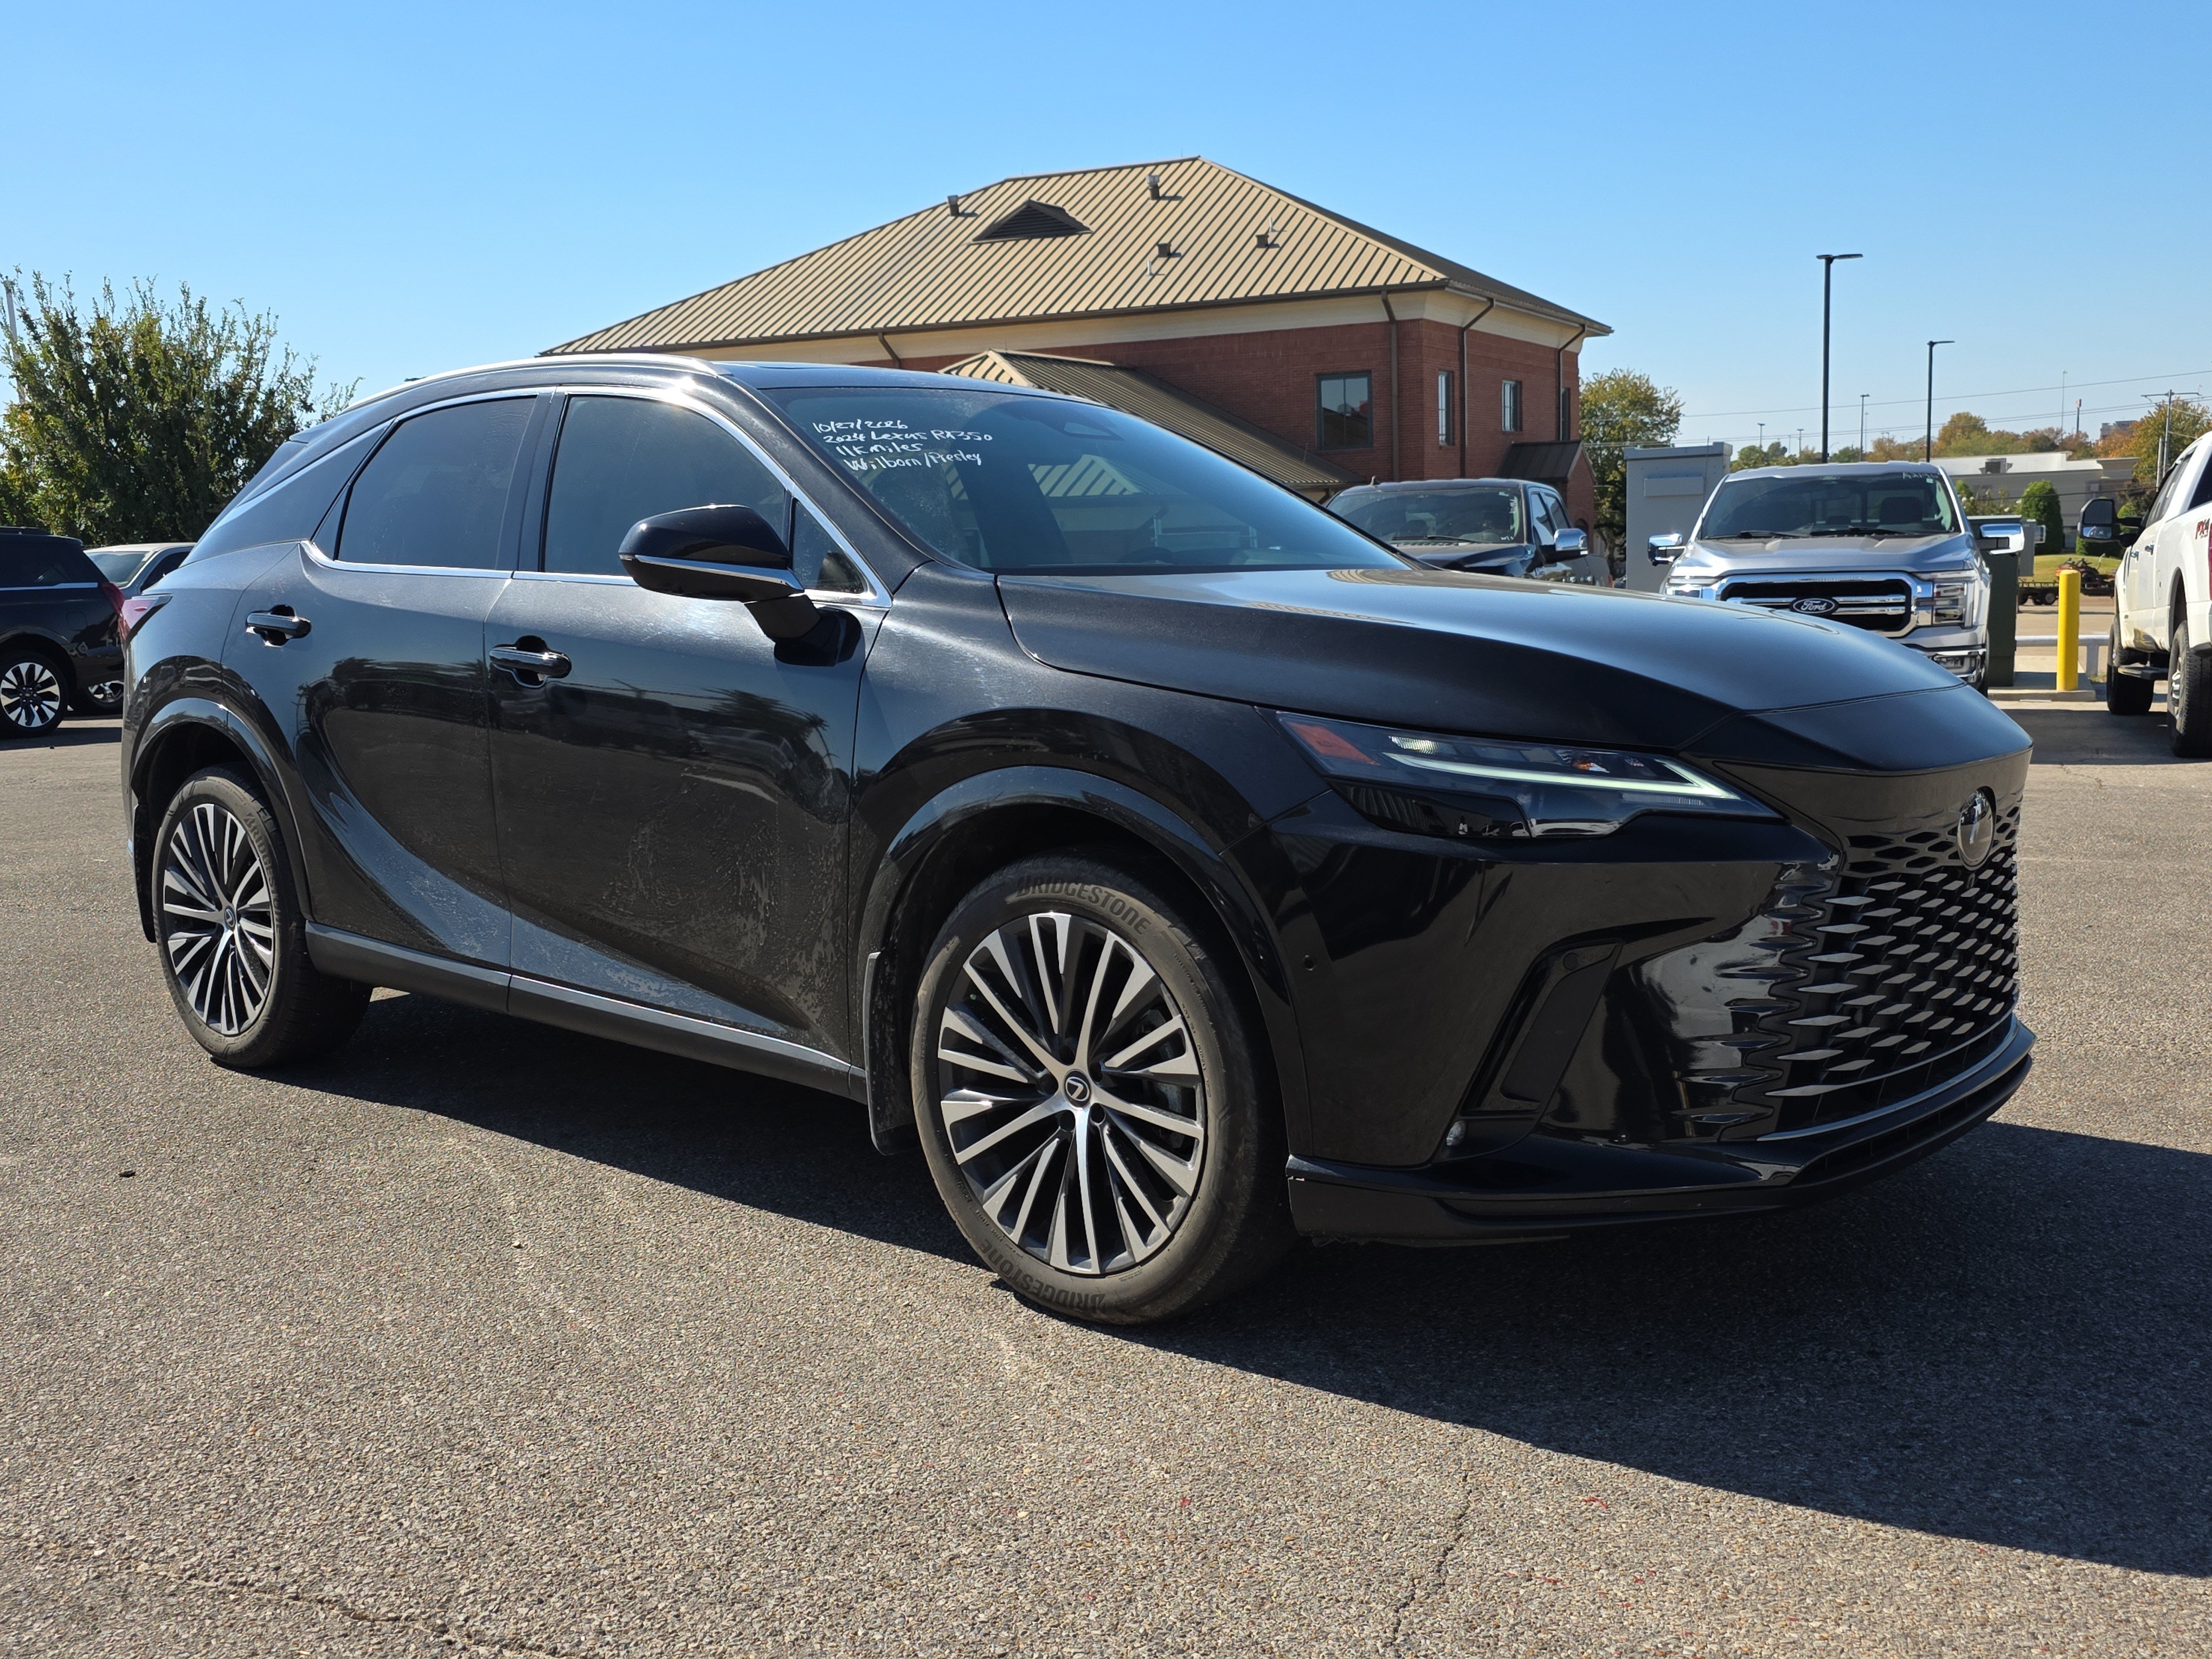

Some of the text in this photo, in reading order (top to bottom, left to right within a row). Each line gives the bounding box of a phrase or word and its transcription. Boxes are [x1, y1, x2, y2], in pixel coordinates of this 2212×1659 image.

[823, 433, 866, 443] 2024
[871, 430, 928, 440] Lexus
[1801, 600, 1827, 610] Ford
[1016, 875, 1152, 935] BRIDGESTONE
